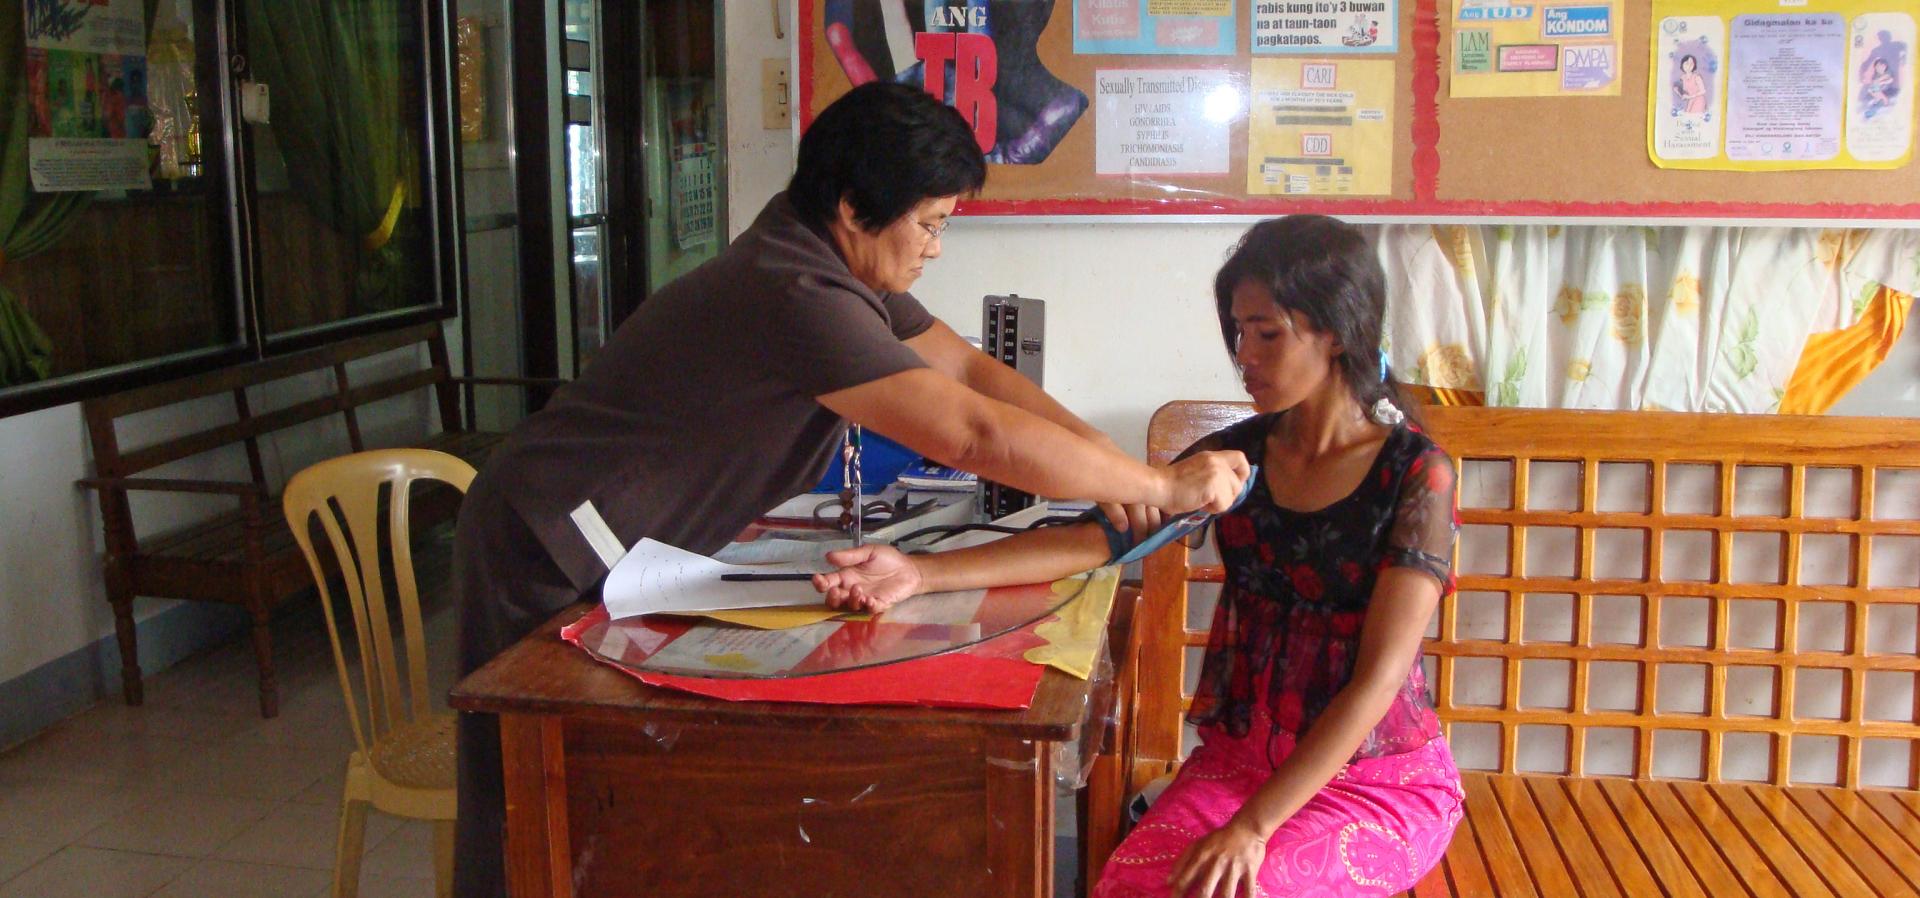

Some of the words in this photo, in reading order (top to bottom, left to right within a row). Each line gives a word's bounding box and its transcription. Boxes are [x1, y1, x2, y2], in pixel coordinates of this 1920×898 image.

[1257, 1, 1284, 14] rabis
[1286, 2, 1313, 14] kung
[1340, 2, 1347, 13] 3
[1349, 1, 1385, 12] buwan
[1481, 7, 1528, 19] IUD
[931, 6, 987, 27] ANG
[1548, 9, 1567, 20] Ang
[1257, 21, 1270, 29] na
[1272, 19, 1284, 29] at
[1285, 18, 1337, 29] taun-taon
[1547, 19, 1608, 33] KONDOM
[1256, 34, 1322, 47] pagkatapos.
[1460, 31, 1489, 51] LAM
[1564, 47, 1609, 68] DMPA
[1306, 67, 1332, 84] CARI
[915, 32, 998, 155] TB
[1099, 77, 1134, 98] Sexually
[1137, 76, 1185, 94] Transmitted
[1129, 117, 1176, 127] GONORRHEA
[1136, 130, 1169, 140] SYPHILIS
[1120, 144, 1184, 153] TRICHOMONIASIS
[1305, 137, 1328, 153] CDD
[1129, 157, 1177, 167] CANDIDIASIS
